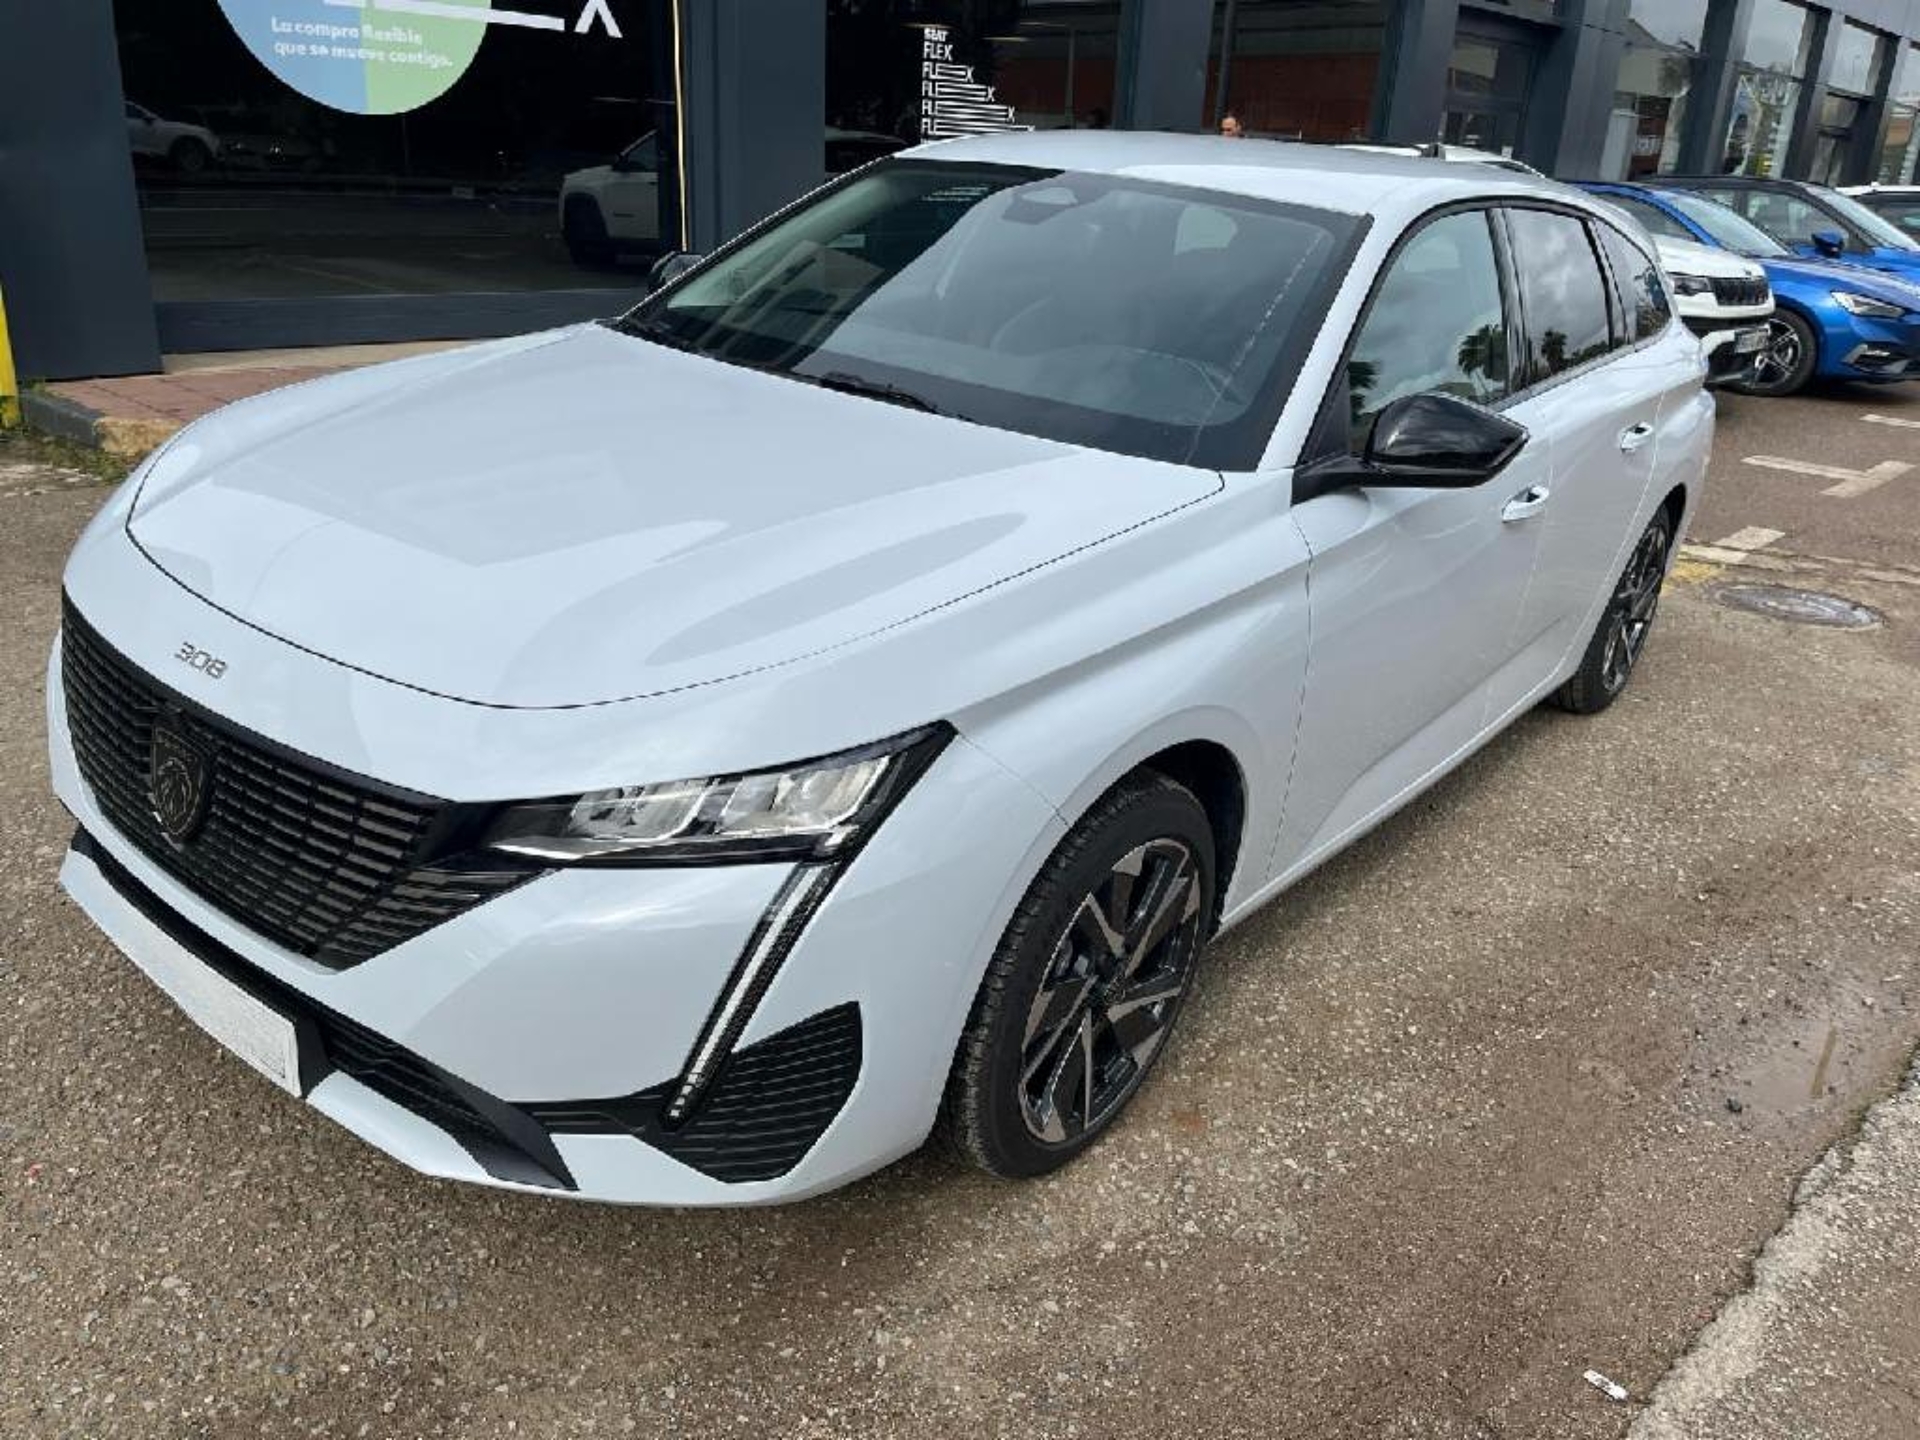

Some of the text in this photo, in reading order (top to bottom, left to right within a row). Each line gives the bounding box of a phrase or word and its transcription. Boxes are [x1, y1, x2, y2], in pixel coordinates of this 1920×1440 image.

[271, 15, 293, 33] La
[274, 42, 307, 58] que
[388, 50, 454, 69] contigo.
[923, 41, 954, 61] FLEX
[922, 61, 974, 84] FLEX
[922, 80, 996, 102] FLEX
[922, 99, 1015, 123] FLEX
[174, 641, 228, 679] 308
